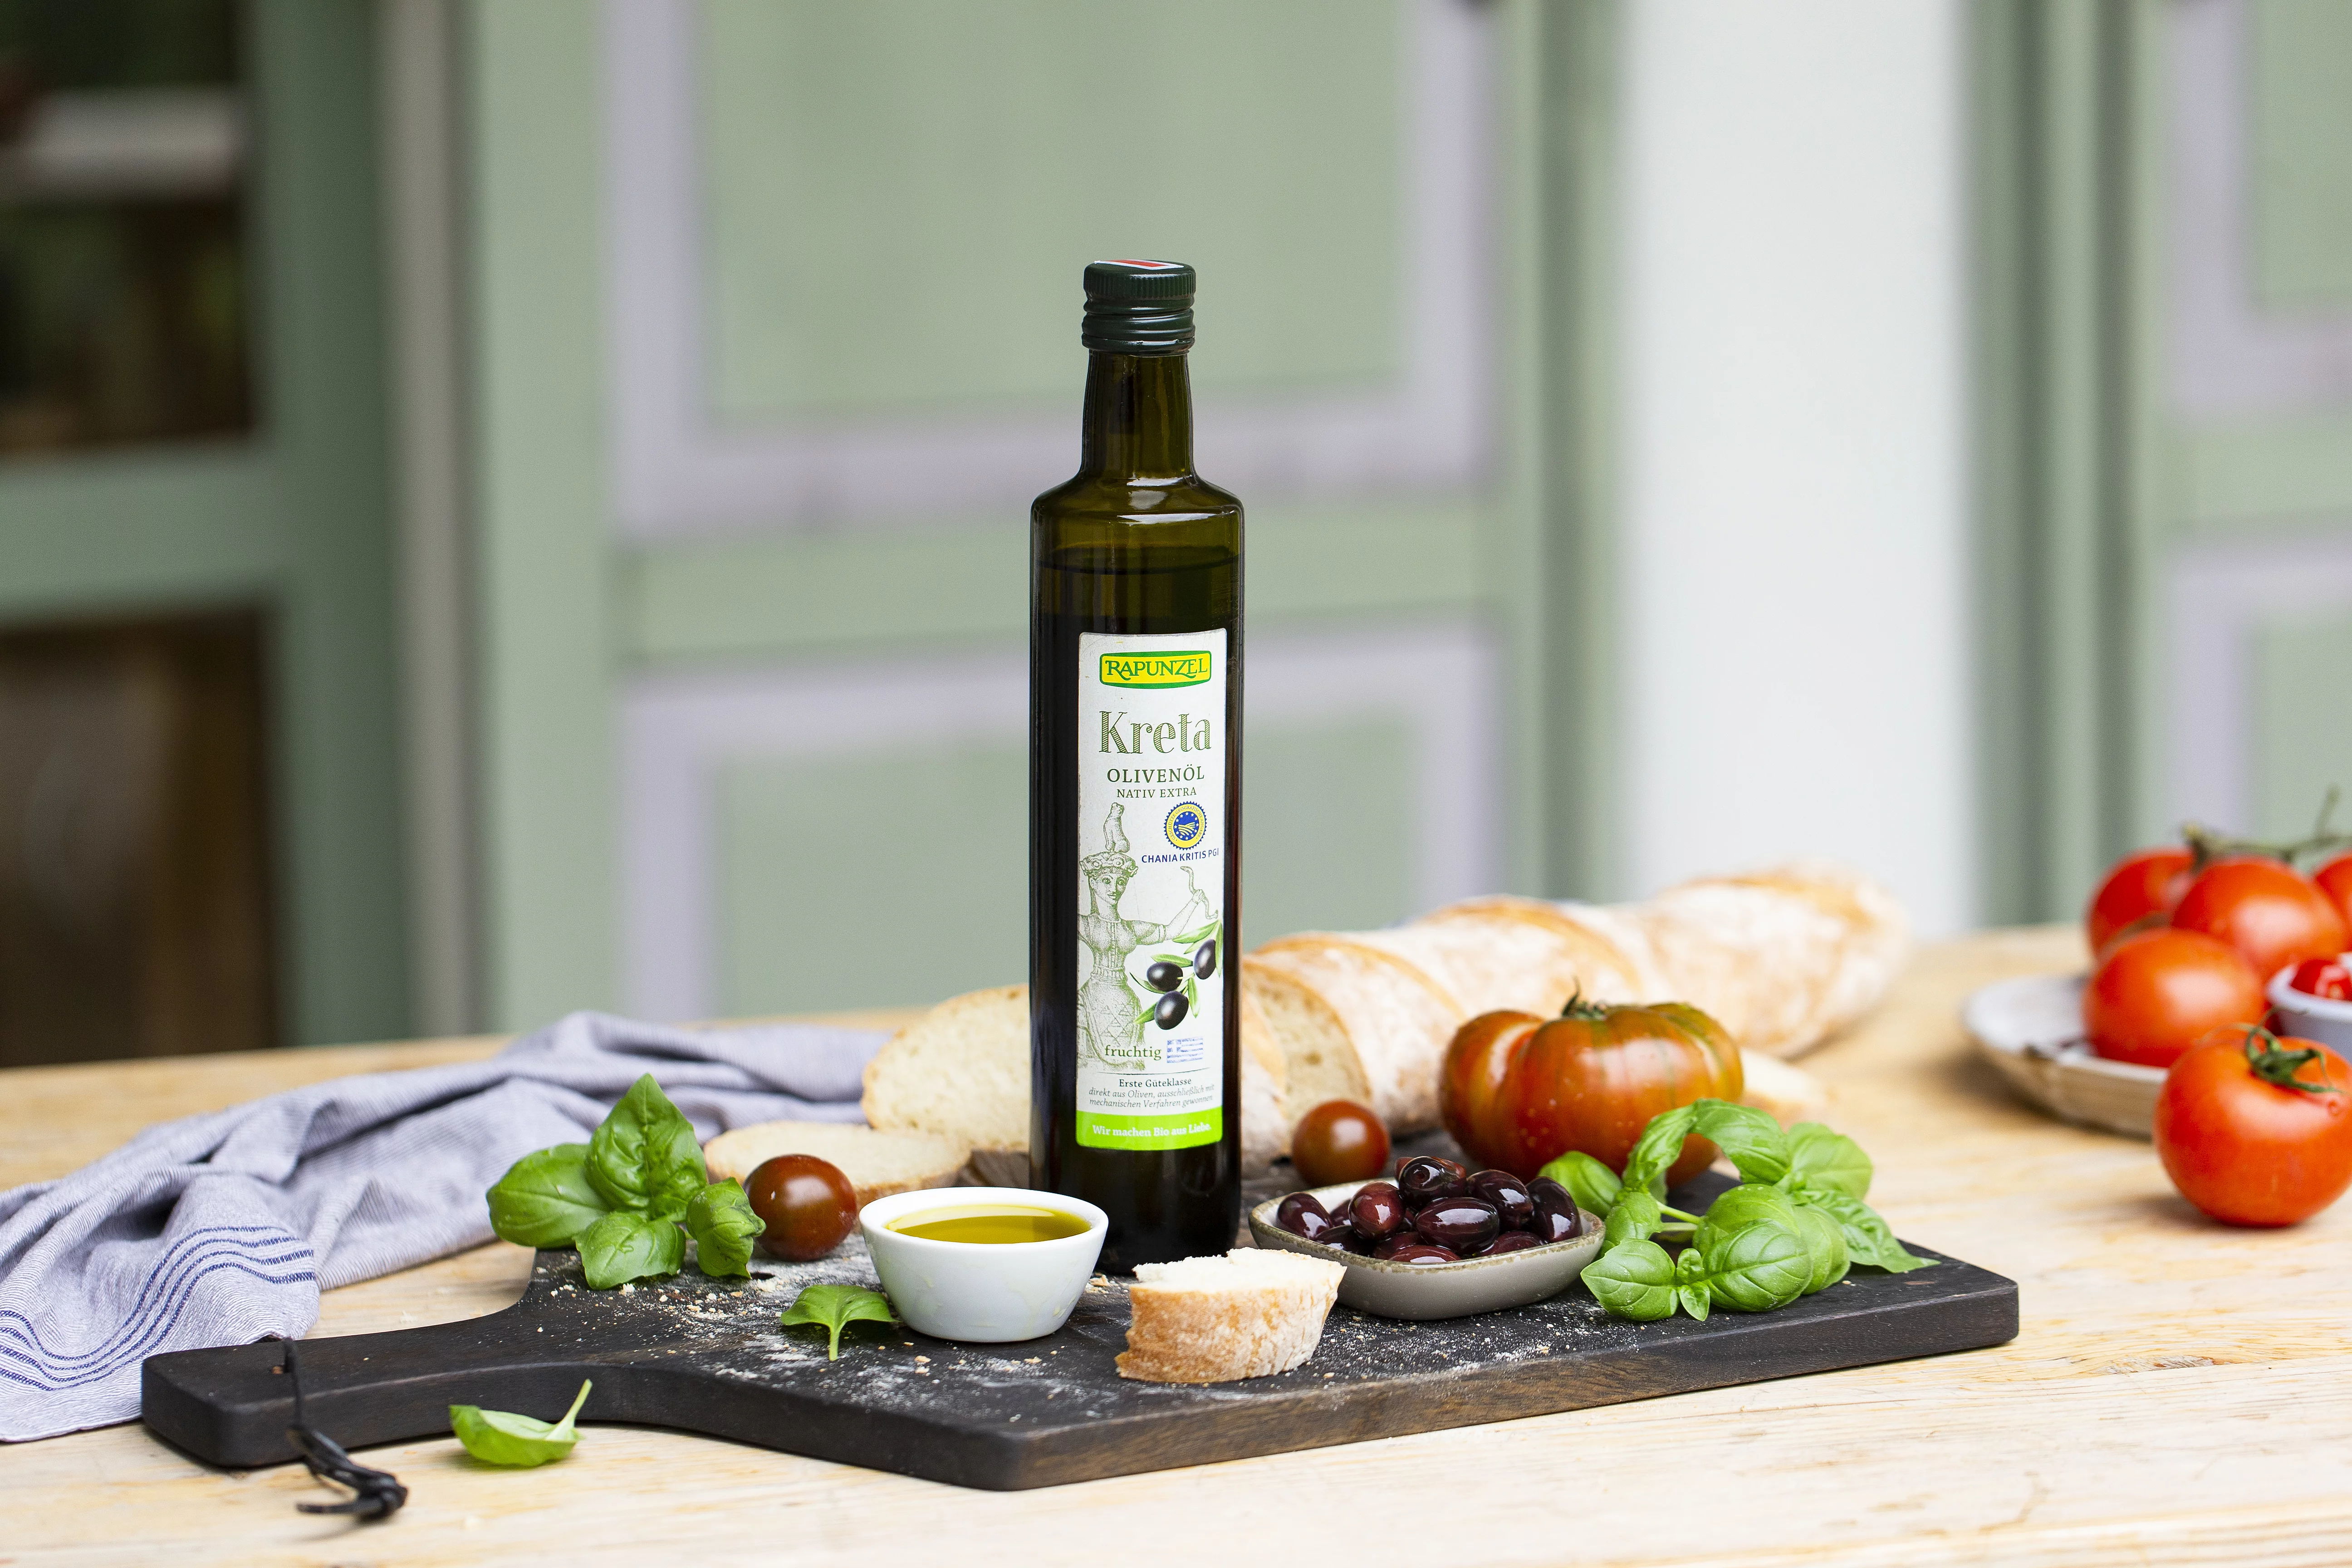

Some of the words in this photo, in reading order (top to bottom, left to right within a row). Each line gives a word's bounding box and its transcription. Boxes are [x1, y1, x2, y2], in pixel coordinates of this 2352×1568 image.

[1105, 658, 1208, 681] RAPUNZEL
[1099, 710, 1212, 754] Kreta
[1107, 764, 1205, 783] OLIVENÖL
[1117, 789, 1155, 799] NATIV
[1160, 787, 1197, 798] EXTRA
[1142, 854, 1178, 863] CHANIA
[1180, 850, 1206, 862] KRITIS
[1208, 848, 1219, 858] PGI
[1104, 1044, 1162, 1061] fruchtig
[1119, 1078, 1143, 1088] Erste
[1145, 1078, 1192, 1088] Güteklasse
[1088, 1087, 1111, 1097] direkt
[1127, 1090, 1155, 1098] Oliven,
[1157, 1084, 1204, 1098] ausschließlich
[1089, 1098, 1141, 1108] mechanischen
[1143, 1099, 1181, 1109] Verfahren
[1181, 1095, 1213, 1107] gewonnen
[1093, 1125, 1111, 1136] Wir
[1112, 1127, 1152, 1137] machen
[1153, 1127, 1170, 1136] Bio
[1171, 1127, 1187, 1135] aus
